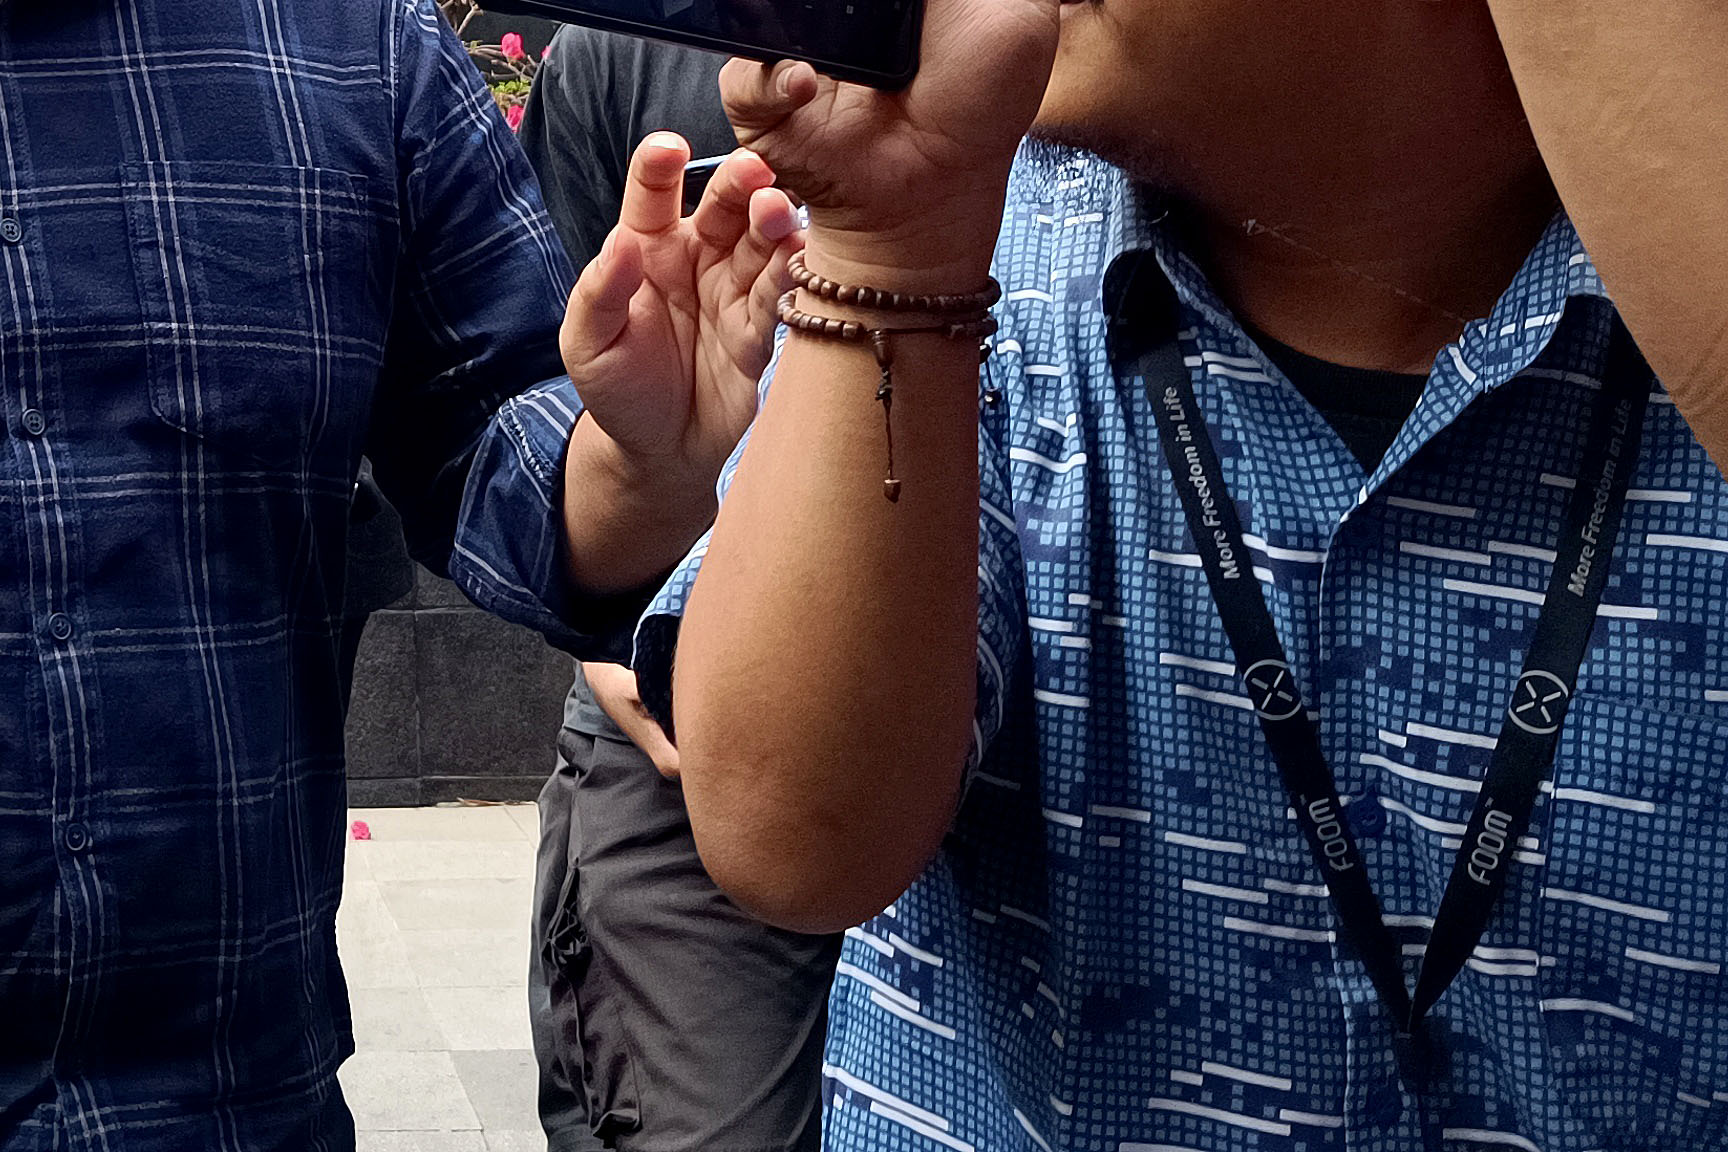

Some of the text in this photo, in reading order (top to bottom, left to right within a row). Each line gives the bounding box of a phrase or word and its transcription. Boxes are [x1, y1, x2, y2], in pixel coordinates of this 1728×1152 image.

[1163, 386, 1241, 580] More Freedom in Life
[1567, 544, 1595, 598] More
[1581, 459, 1617, 545] Freedom
